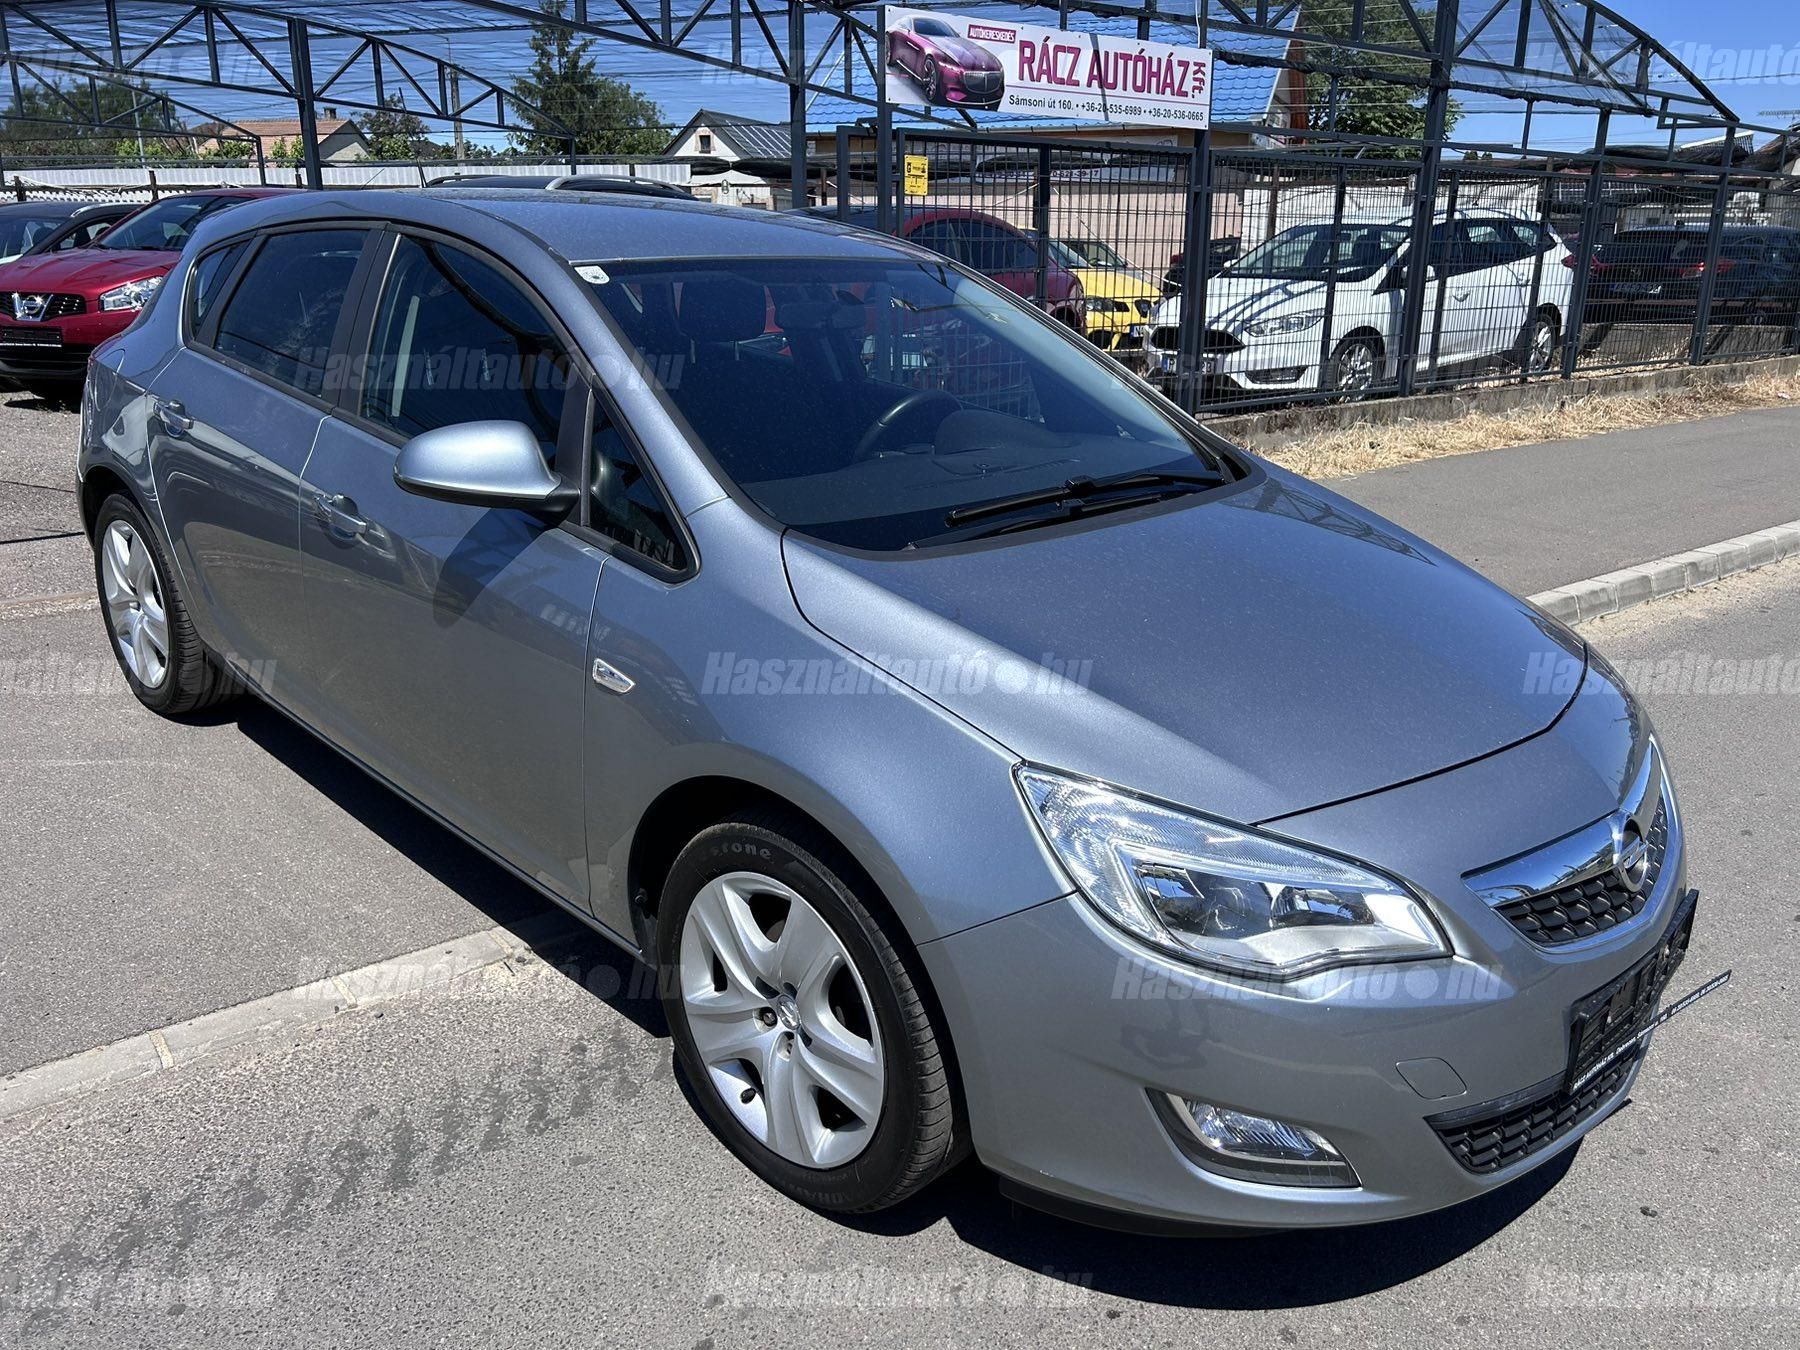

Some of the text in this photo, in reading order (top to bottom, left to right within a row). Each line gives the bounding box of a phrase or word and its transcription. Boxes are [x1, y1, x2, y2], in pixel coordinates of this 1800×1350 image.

[1018, 36, 1190, 98] RÁCZ AUTÓHÁZ
[1008, 94, 1046, 108] Sámsoni
